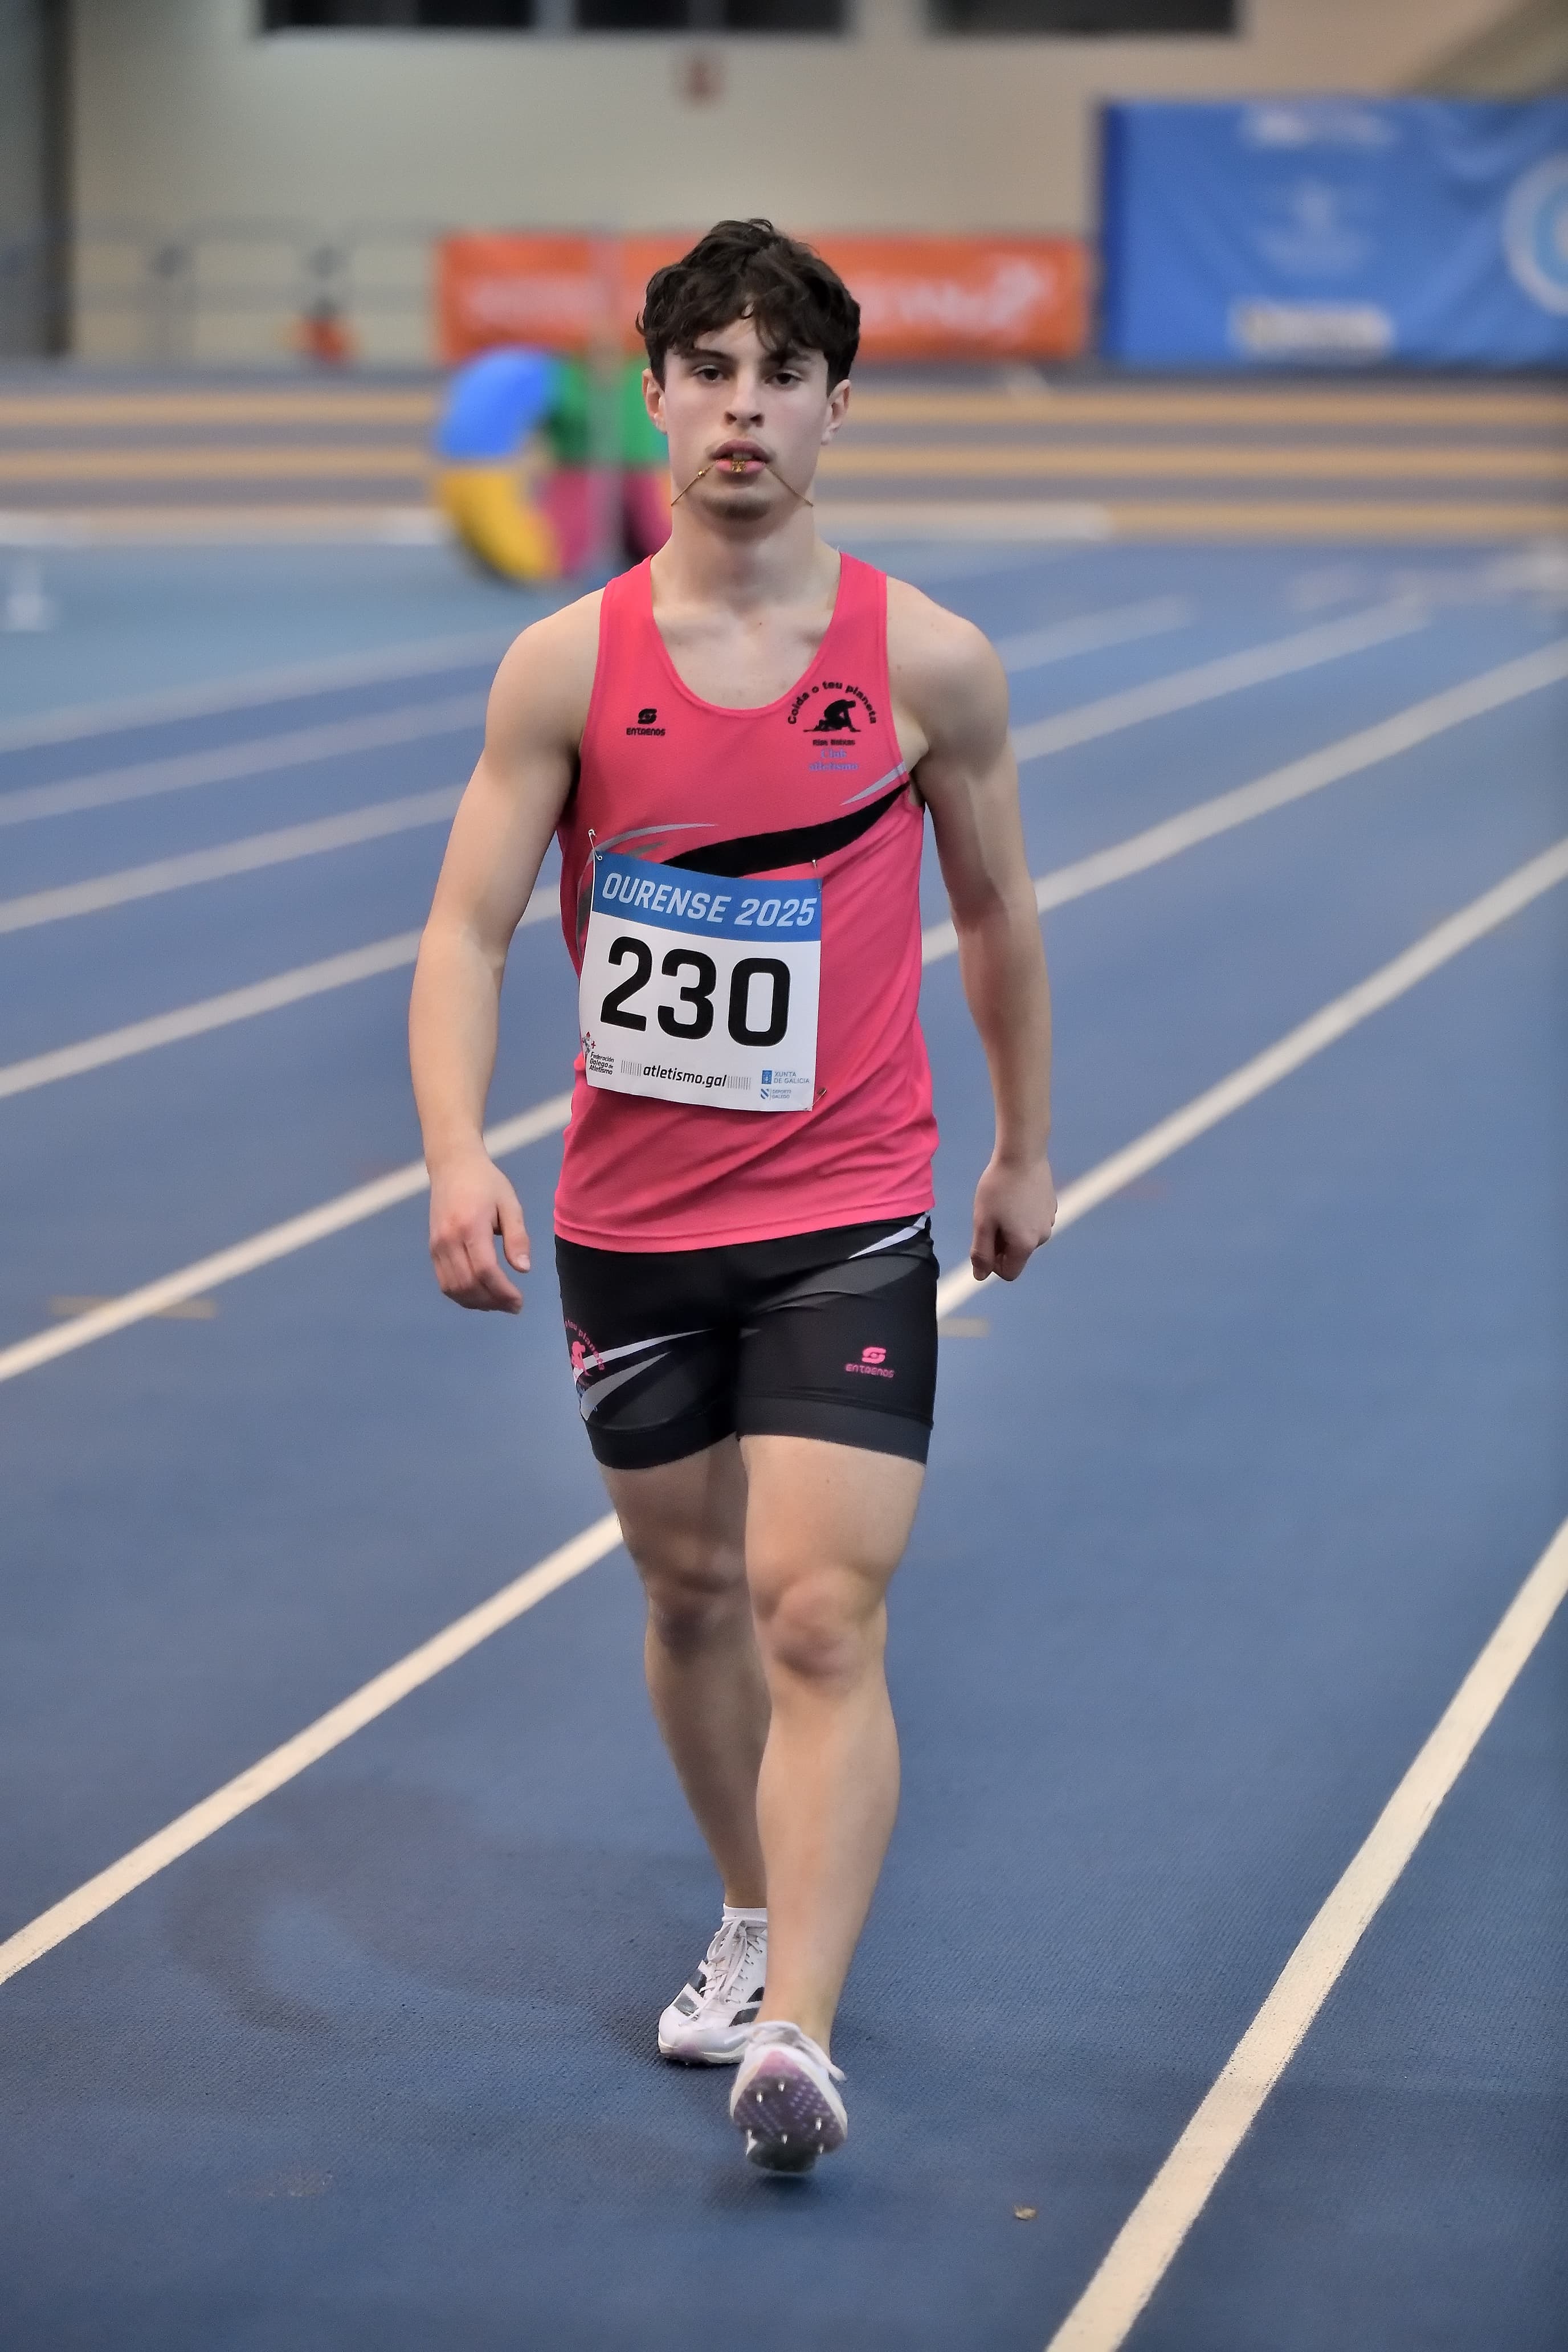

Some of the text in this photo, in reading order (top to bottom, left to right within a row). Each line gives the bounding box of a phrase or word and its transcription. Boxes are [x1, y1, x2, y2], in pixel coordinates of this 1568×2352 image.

[822, 681, 843, 689] teu
[846, 685, 876, 724] planeta
[602, 873, 817, 927] OURENSE 2025
[601, 936, 791, 1047] 230
[589, 1064, 612, 1075] Atletismo
[590, 1051, 614, 1063] Federación
[590, 1058, 608, 1068] Galego
[643, 1065, 727, 1088] atletismo.gal
[578, 1329, 605, 1370] planeta
